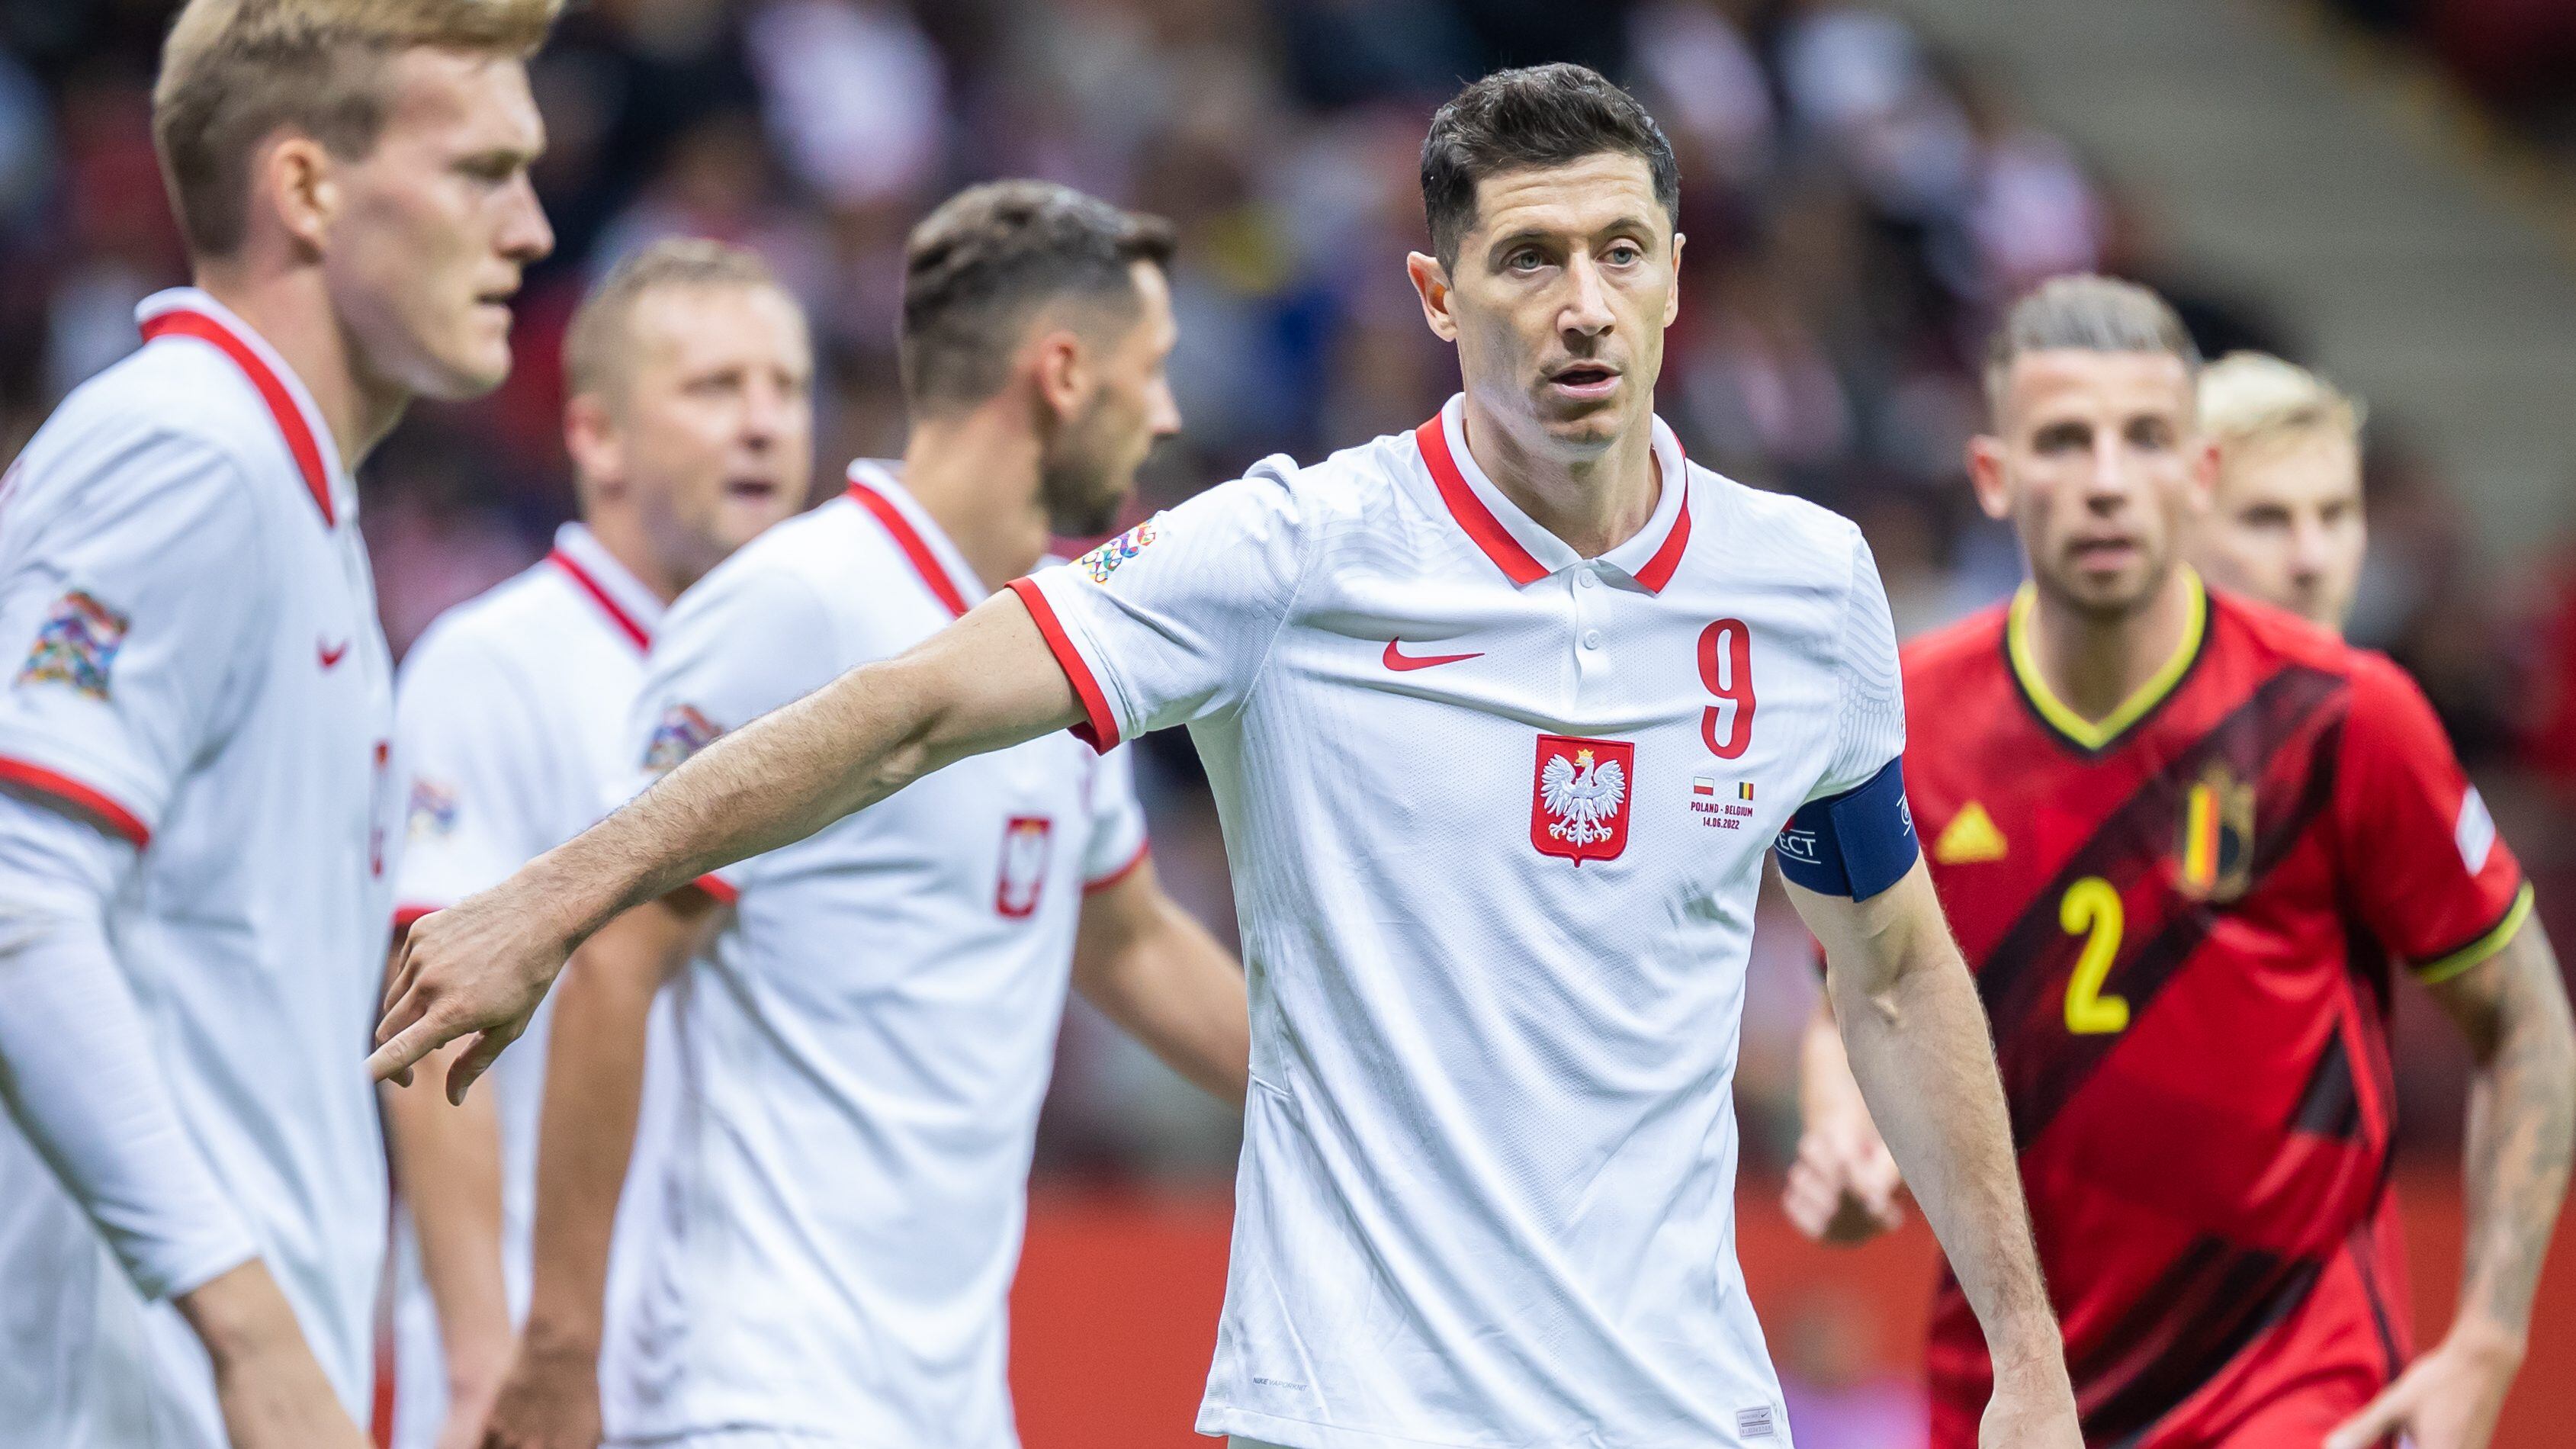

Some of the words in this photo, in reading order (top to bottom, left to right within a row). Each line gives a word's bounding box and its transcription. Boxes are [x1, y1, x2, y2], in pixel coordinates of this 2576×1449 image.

[1698, 618, 1756, 760] 9
[1691, 802, 1718, 814] POLAND
[1725, 805, 1753, 818] BELGIUM
[1703, 817, 1739, 830] 14.06.2022
[2060, 876, 2130, 1034] 2
[1270, 1379, 1307, 1391] VAPORKNIT
